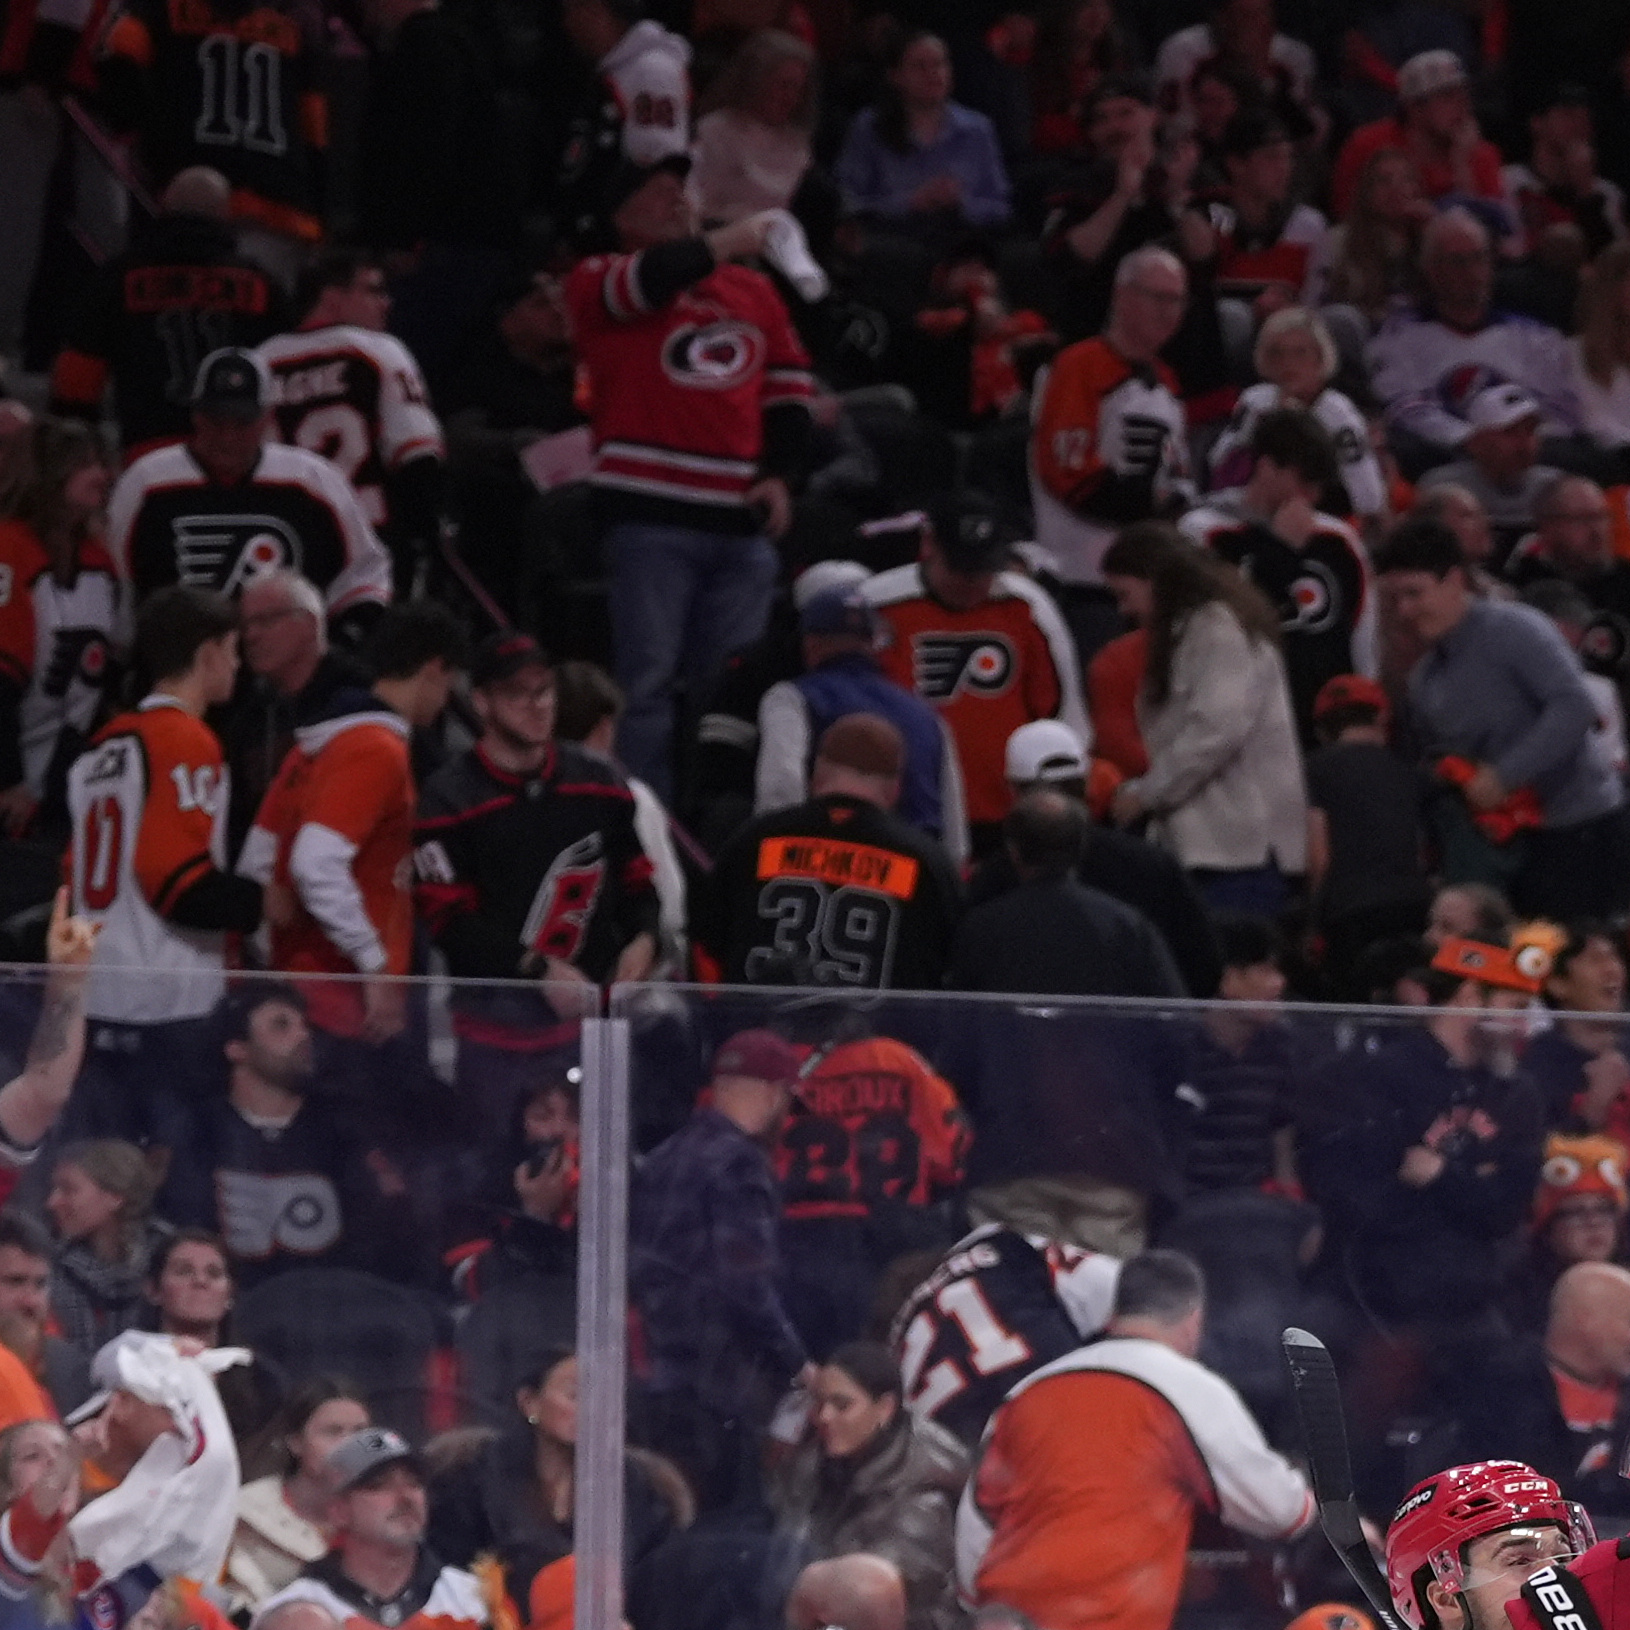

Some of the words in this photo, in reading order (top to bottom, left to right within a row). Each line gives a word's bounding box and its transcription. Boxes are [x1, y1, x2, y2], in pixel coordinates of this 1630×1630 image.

[195, 32, 287, 156] 11
[744, 875, 898, 1010] 39
[1503, 1480, 1549, 1494] CCM
